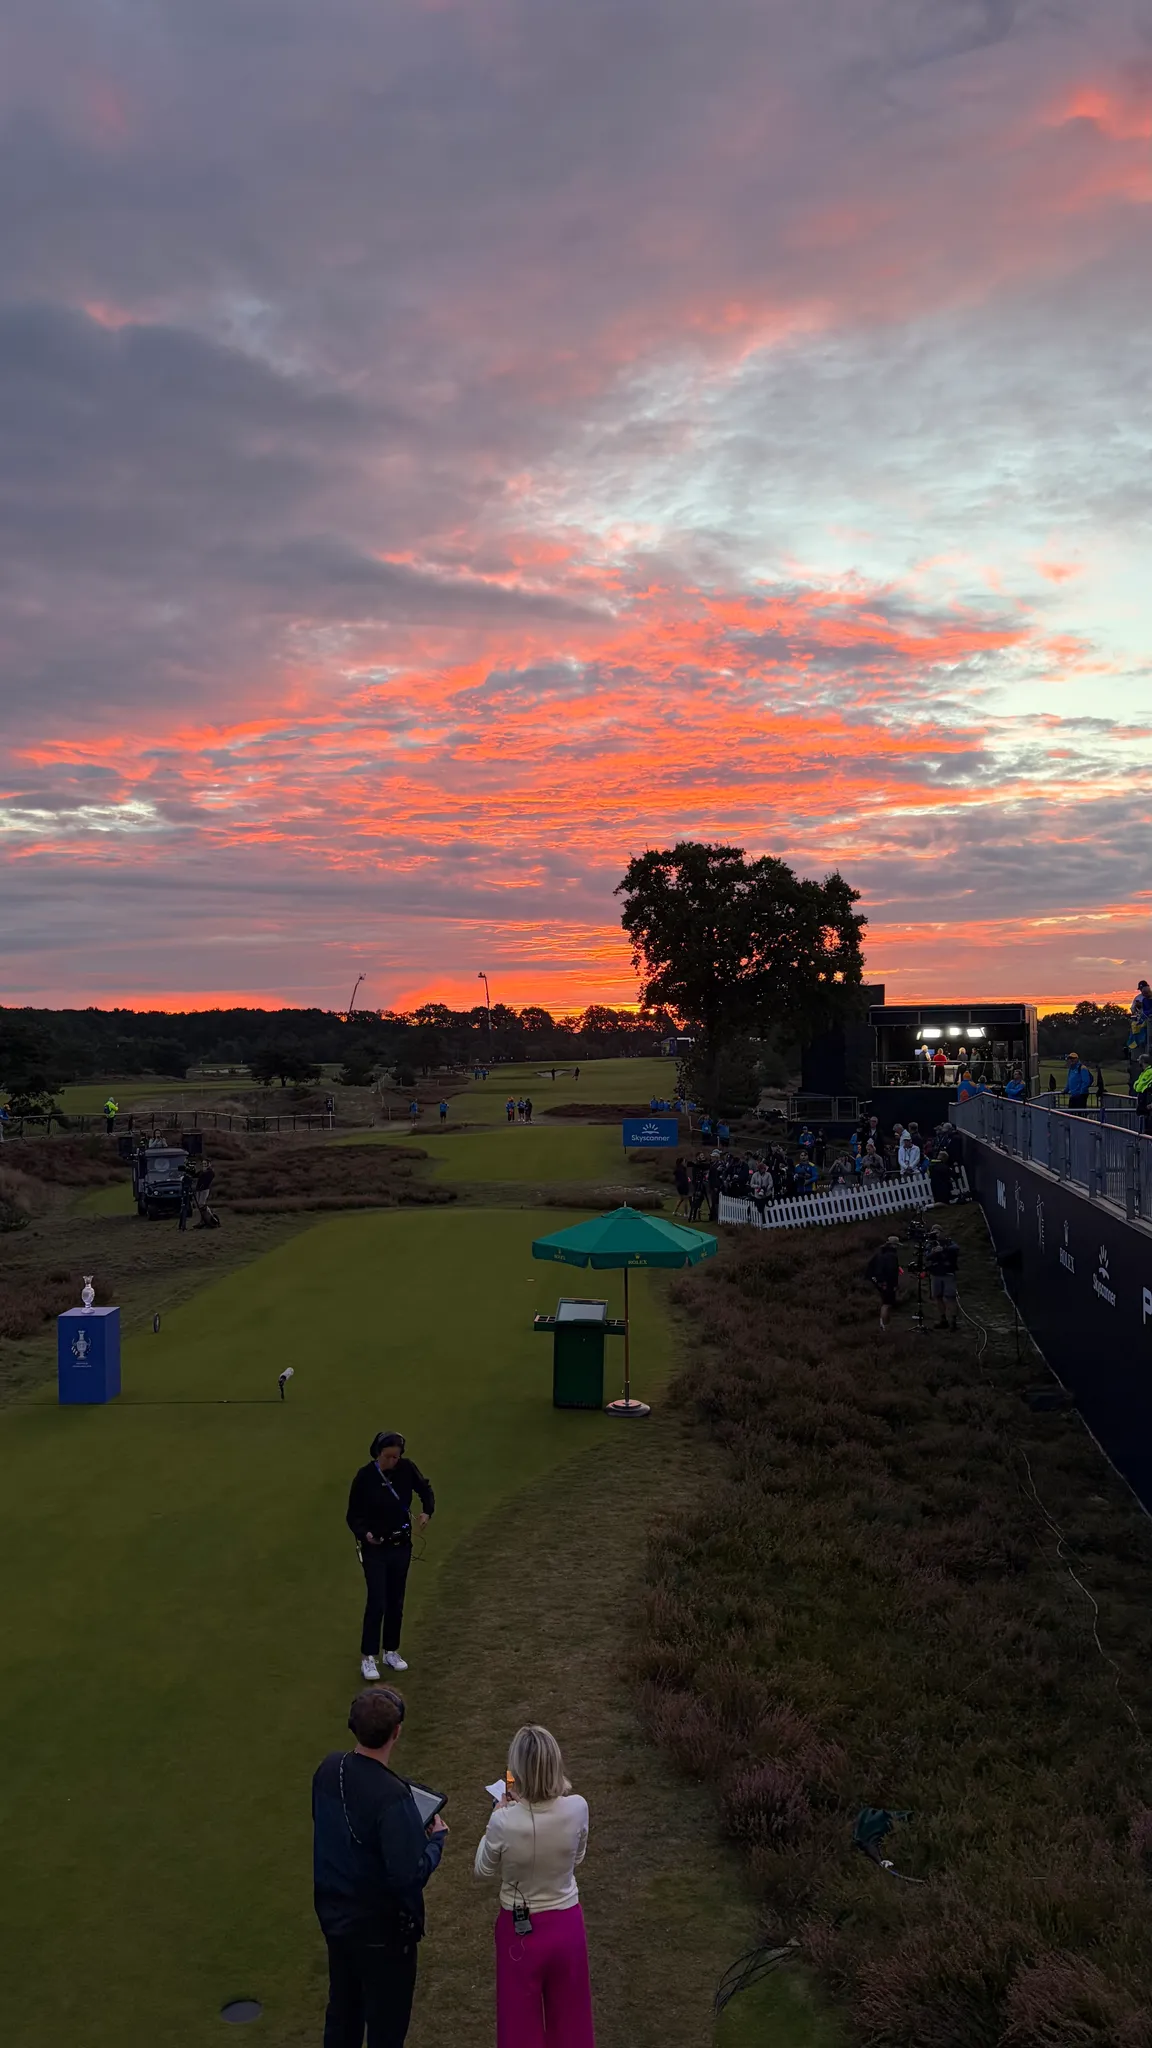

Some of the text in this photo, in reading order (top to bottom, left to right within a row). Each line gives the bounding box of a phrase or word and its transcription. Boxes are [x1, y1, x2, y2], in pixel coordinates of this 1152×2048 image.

[631, 1134, 670, 1142] Skyscanner
[1059, 1246, 1075, 1274] ROLEX
[1092, 1272, 1117, 1308] Skyscanner
